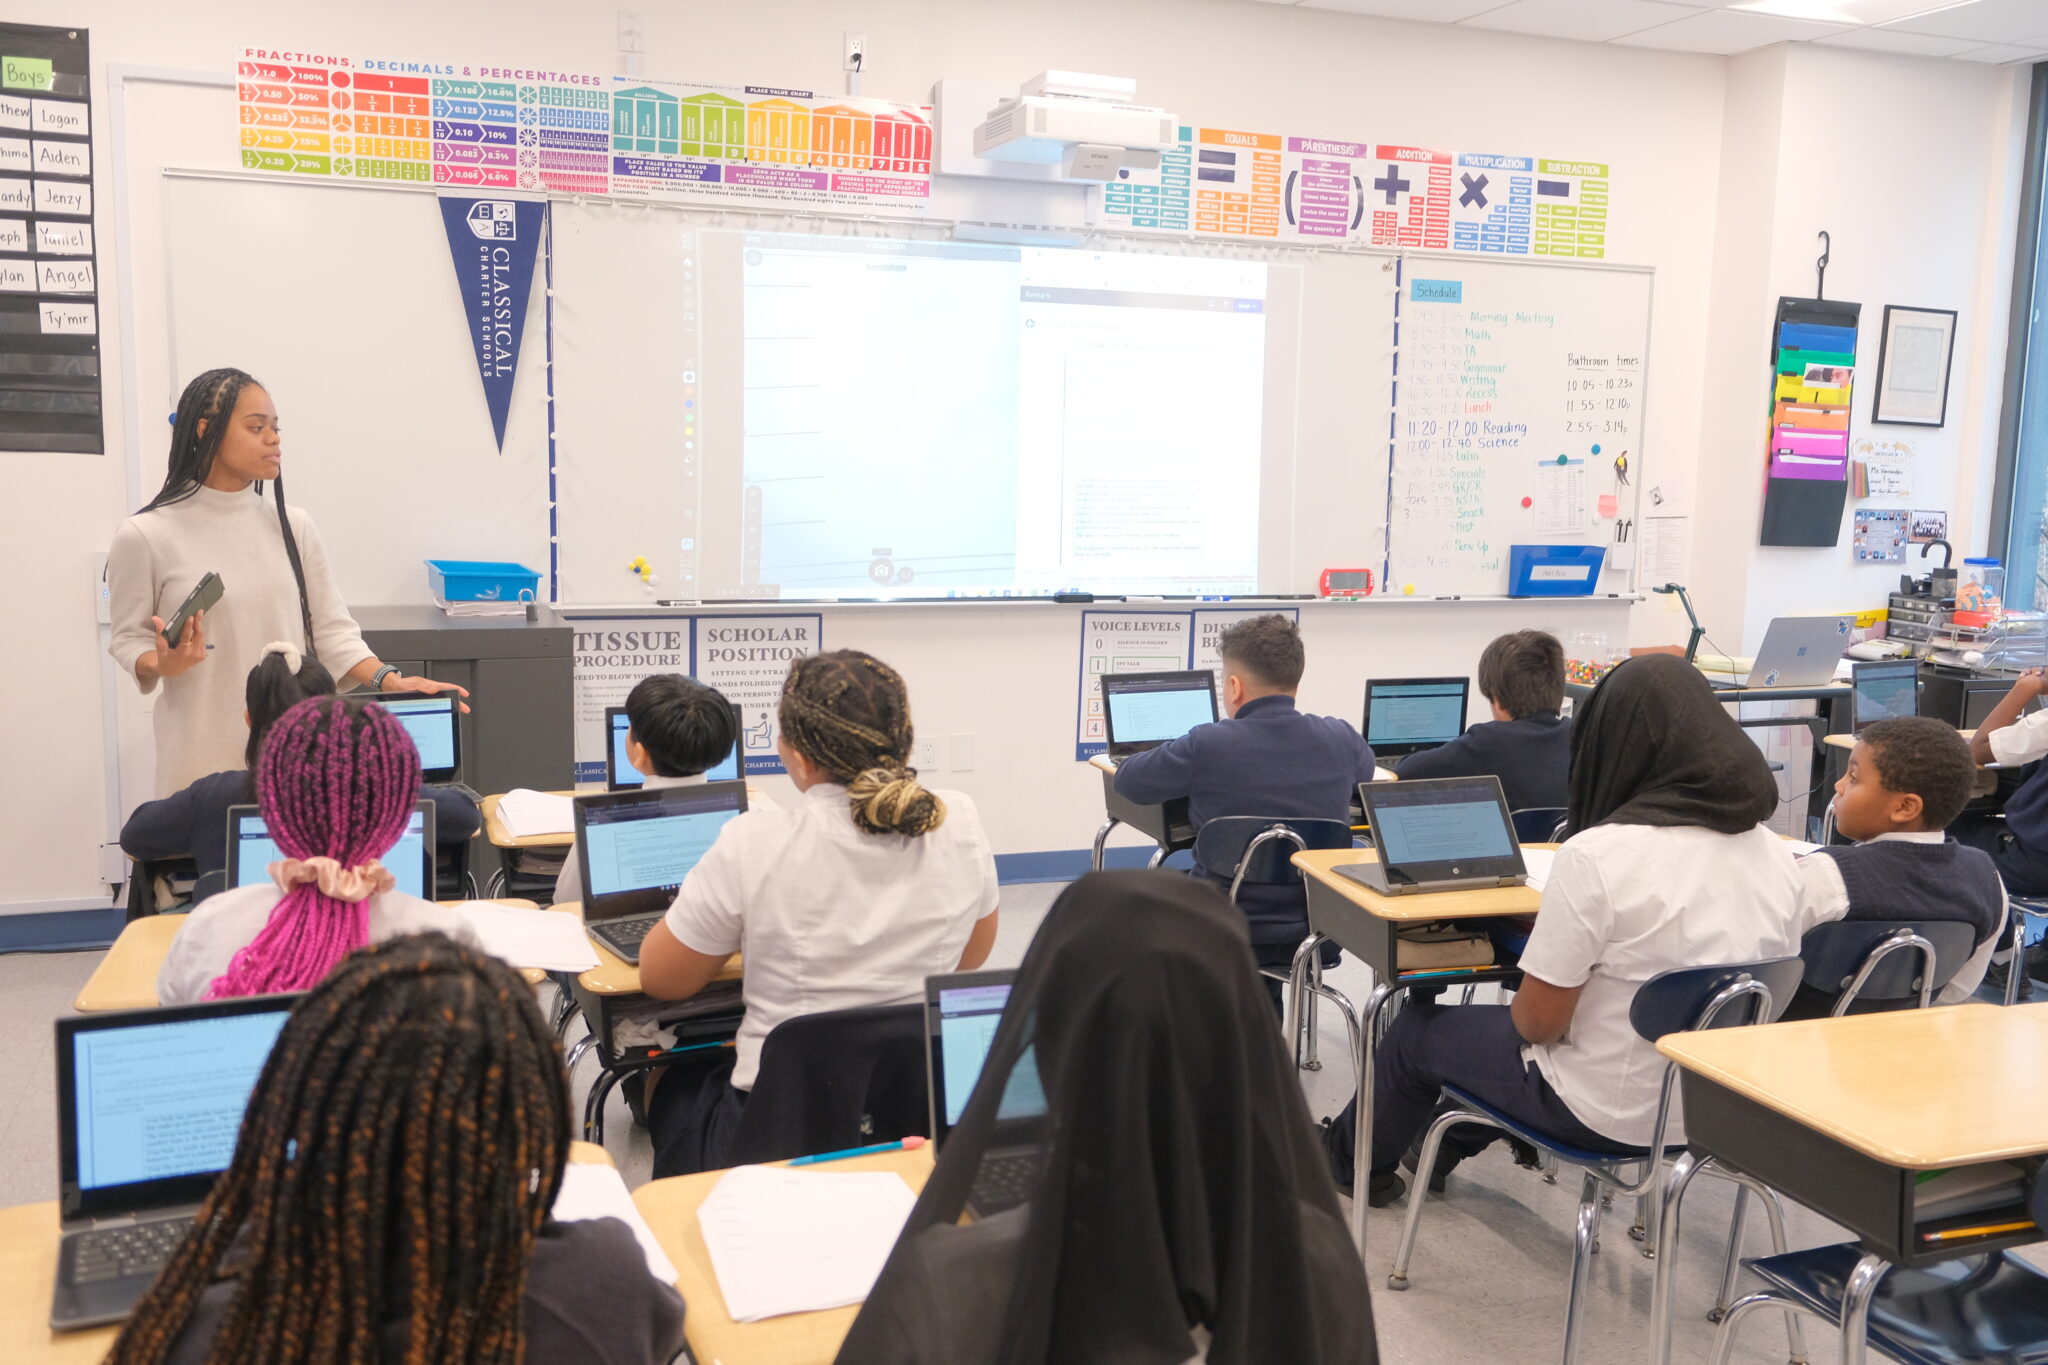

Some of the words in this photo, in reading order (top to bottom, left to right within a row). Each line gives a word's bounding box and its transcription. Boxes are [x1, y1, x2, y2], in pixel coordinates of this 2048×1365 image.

[7, 63, 45, 87] Boys
[298, 73, 324, 82] 100%
[365, 60, 454, 75] DECIMALS
[463, 66, 472, 76] &
[480, 67, 601, 86] PERCENTAGES
[42, 109, 79, 128] Logan
[488, 131, 507, 140] 10%
[1224, 133, 1258, 146] EQUALS
[731, 148, 738, 157] 9
[752, 150, 760, 159] 3
[1302, 141, 1355, 156] PARENTHESIS
[1396, 149, 1433, 161] ADDITION
[40, 147, 81, 166] Aiden
[775, 151, 780, 160] 1
[795, 153, 803, 162] 6
[816, 155, 824, 164] 4
[837, 157, 845, 166] 8
[1465, 155, 1526, 169] MULTIPLICATION
[858, 159, 865, 168] 2
[878, 160, 885, 168] 7
[898, 162, 905, 170] 3
[918, 164, 924, 172] 5
[1547, 162, 1600, 175] SUBTRACTION
[1, 189, 30, 208] andy
[44, 188, 82, 210] Jenzy
[45, 266, 91, 289] Angel
[480, 246, 490, 307] CHARTER
[1417, 283, 1457, 298] Schedule
[45, 310, 89, 328] Ty'mir
[492, 247, 512, 378] CLASSICAL
[1470, 311, 1508, 326] Morning
[1516, 311, 1555, 327] Meeting
[1465, 328, 1491, 341] Math
[482, 316, 492, 378] SCHOOLS
[1463, 359, 1507, 373] Grammar
[1567, 352, 1609, 367] Bathroom
[1617, 354, 1639, 366] times
[1460, 373, 1496, 388] Writing
[1465, 387, 1498, 399] Recess
[1464, 401, 1492, 414] Lunch
[1483, 420, 1527, 436] Reading
[1478, 438, 1519, 449] Science
[1456, 451, 1479, 461] Latin
[1450, 466, 1486, 481] Specials
[1457, 506, 1485, 519] Snack
[1092, 621, 1132, 632] VOICE
[1134, 621, 1181, 632] LEVELS
[708, 627, 808, 642] SCHOLAR
[574, 631, 681, 652] TISSUE
[1095, 638, 1103, 650] 0
[574, 654, 681, 667] PROCEDURE
[708, 647, 809, 662] POSITION
[1096, 660, 1100, 670] 1
[1093, 680, 1101, 691] 2
[1092, 702, 1099, 712] 3
[1091, 722, 1098, 733] 4
[574, 768, 608, 776] CLASSICA
